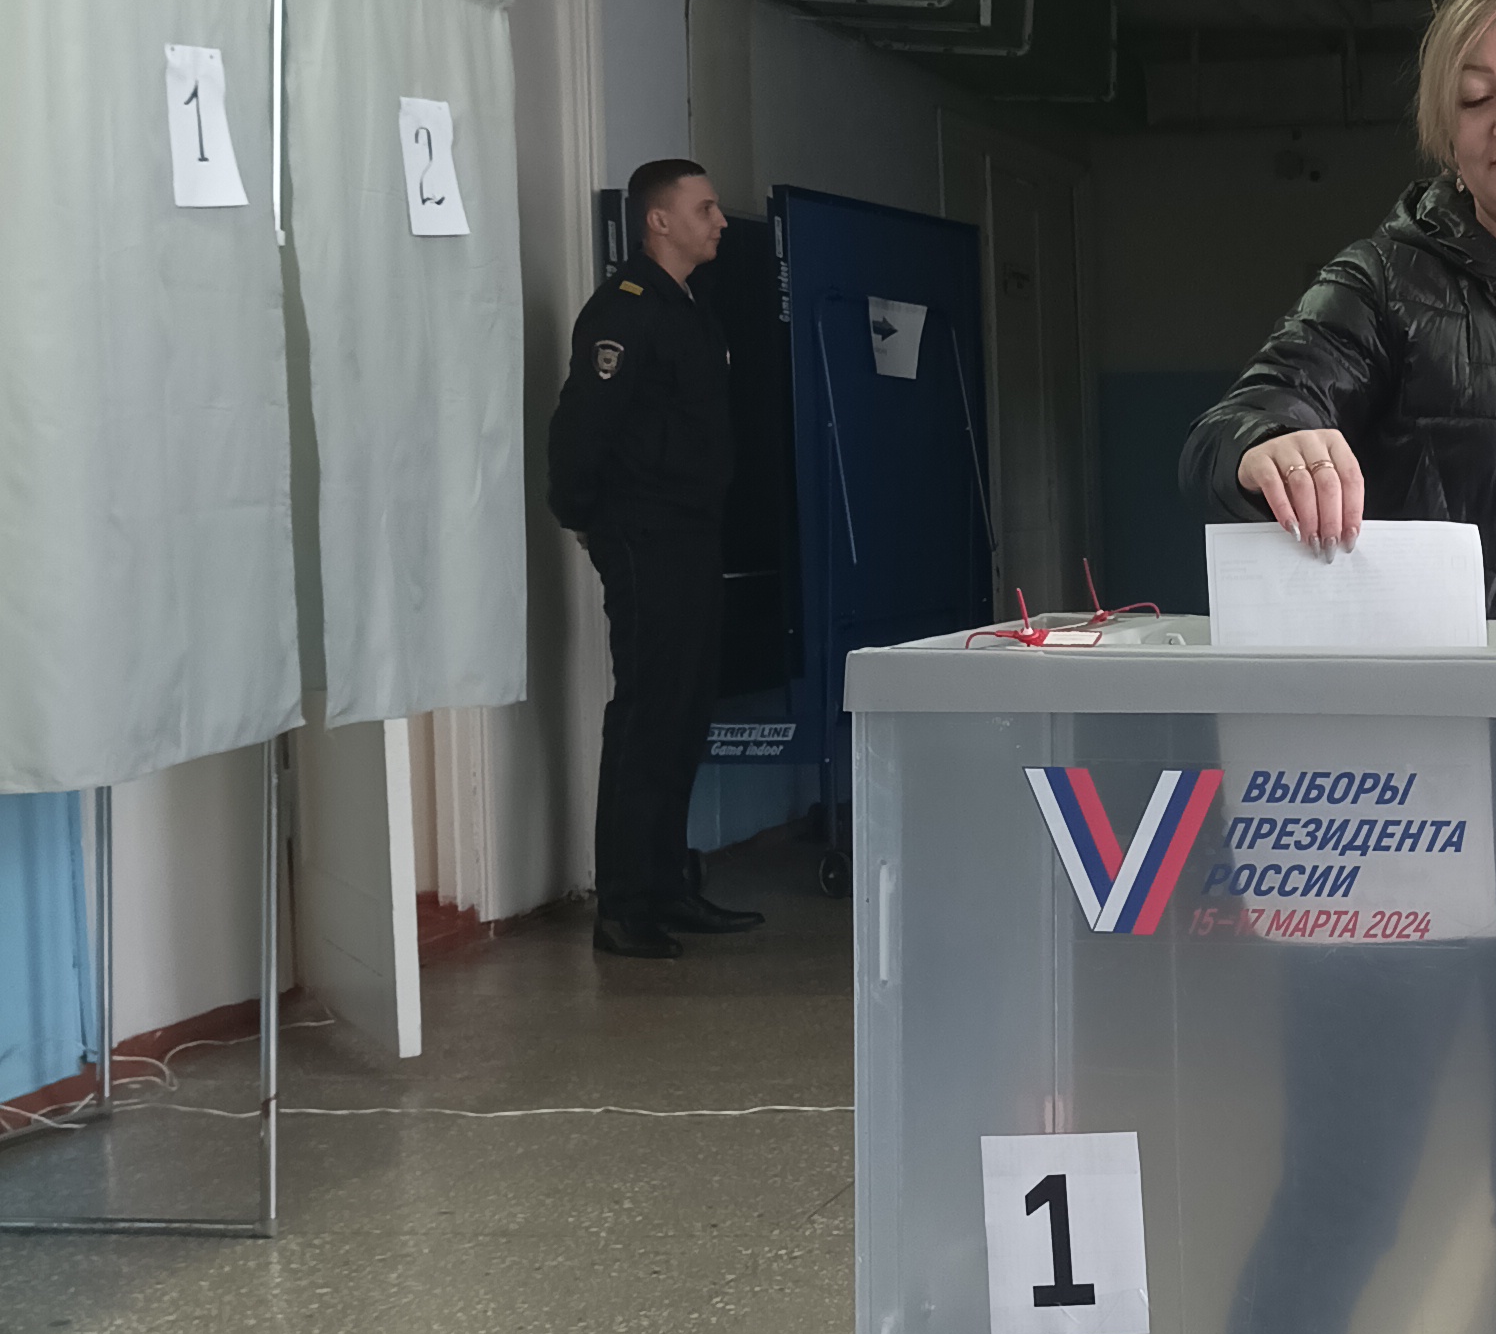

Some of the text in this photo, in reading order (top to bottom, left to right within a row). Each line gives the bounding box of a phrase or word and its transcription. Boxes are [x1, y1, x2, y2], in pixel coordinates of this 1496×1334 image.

[183, 80, 210, 162] 1
[414, 126, 446, 205] 2
[711, 742, 784, 756] Game indoor
[1242, 771, 1417, 805] ВЫБОРЫ
[1223, 817, 1467, 857] ПРЕЗИДЕНТА
[1201, 865, 1361, 898] РОССИИ
[1265, 910, 1359, 939] МАРТА
[1363, 911, 1432, 940] 2024
[1025, 1173, 1096, 1307] 1
